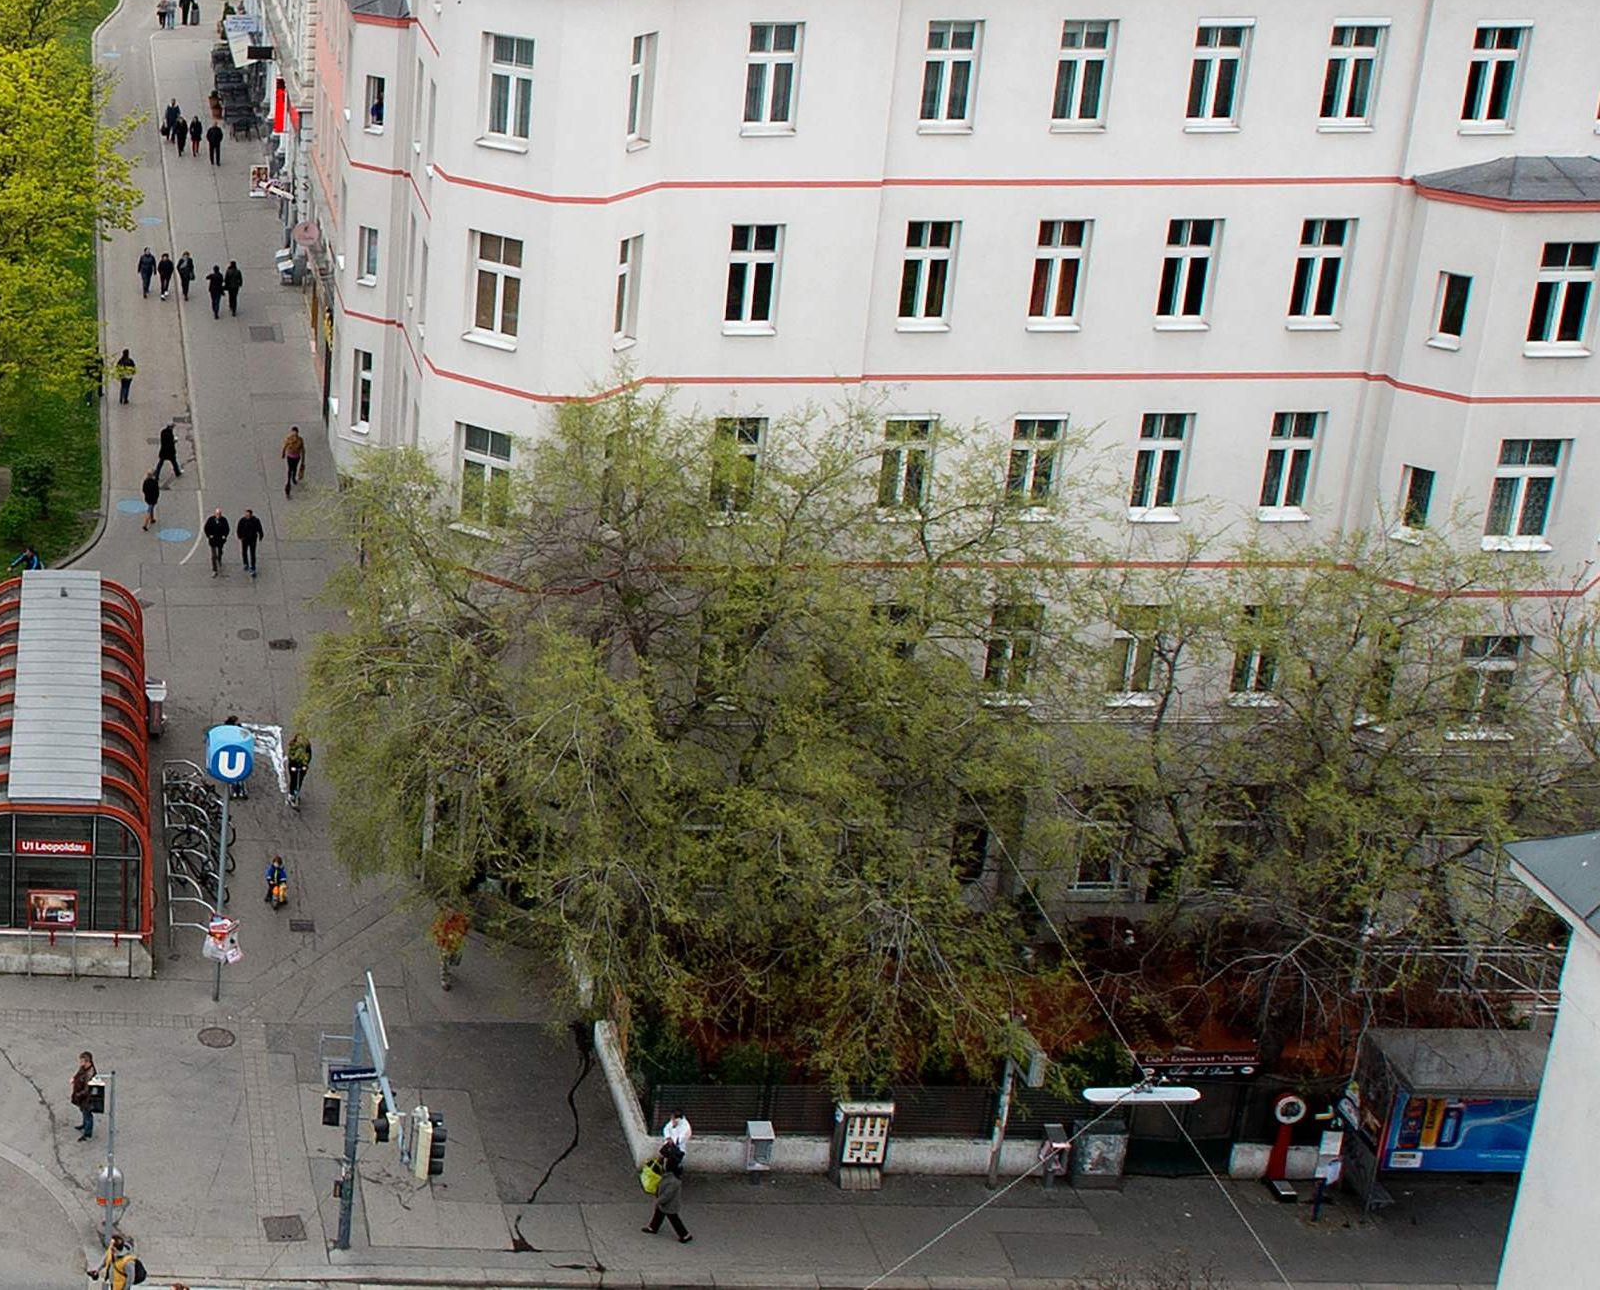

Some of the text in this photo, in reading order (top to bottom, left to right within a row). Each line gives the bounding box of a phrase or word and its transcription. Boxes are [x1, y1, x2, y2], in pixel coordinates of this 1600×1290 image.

[218, 751, 246, 779] U
[22, 841, 87, 853] U1 Leopoldau
